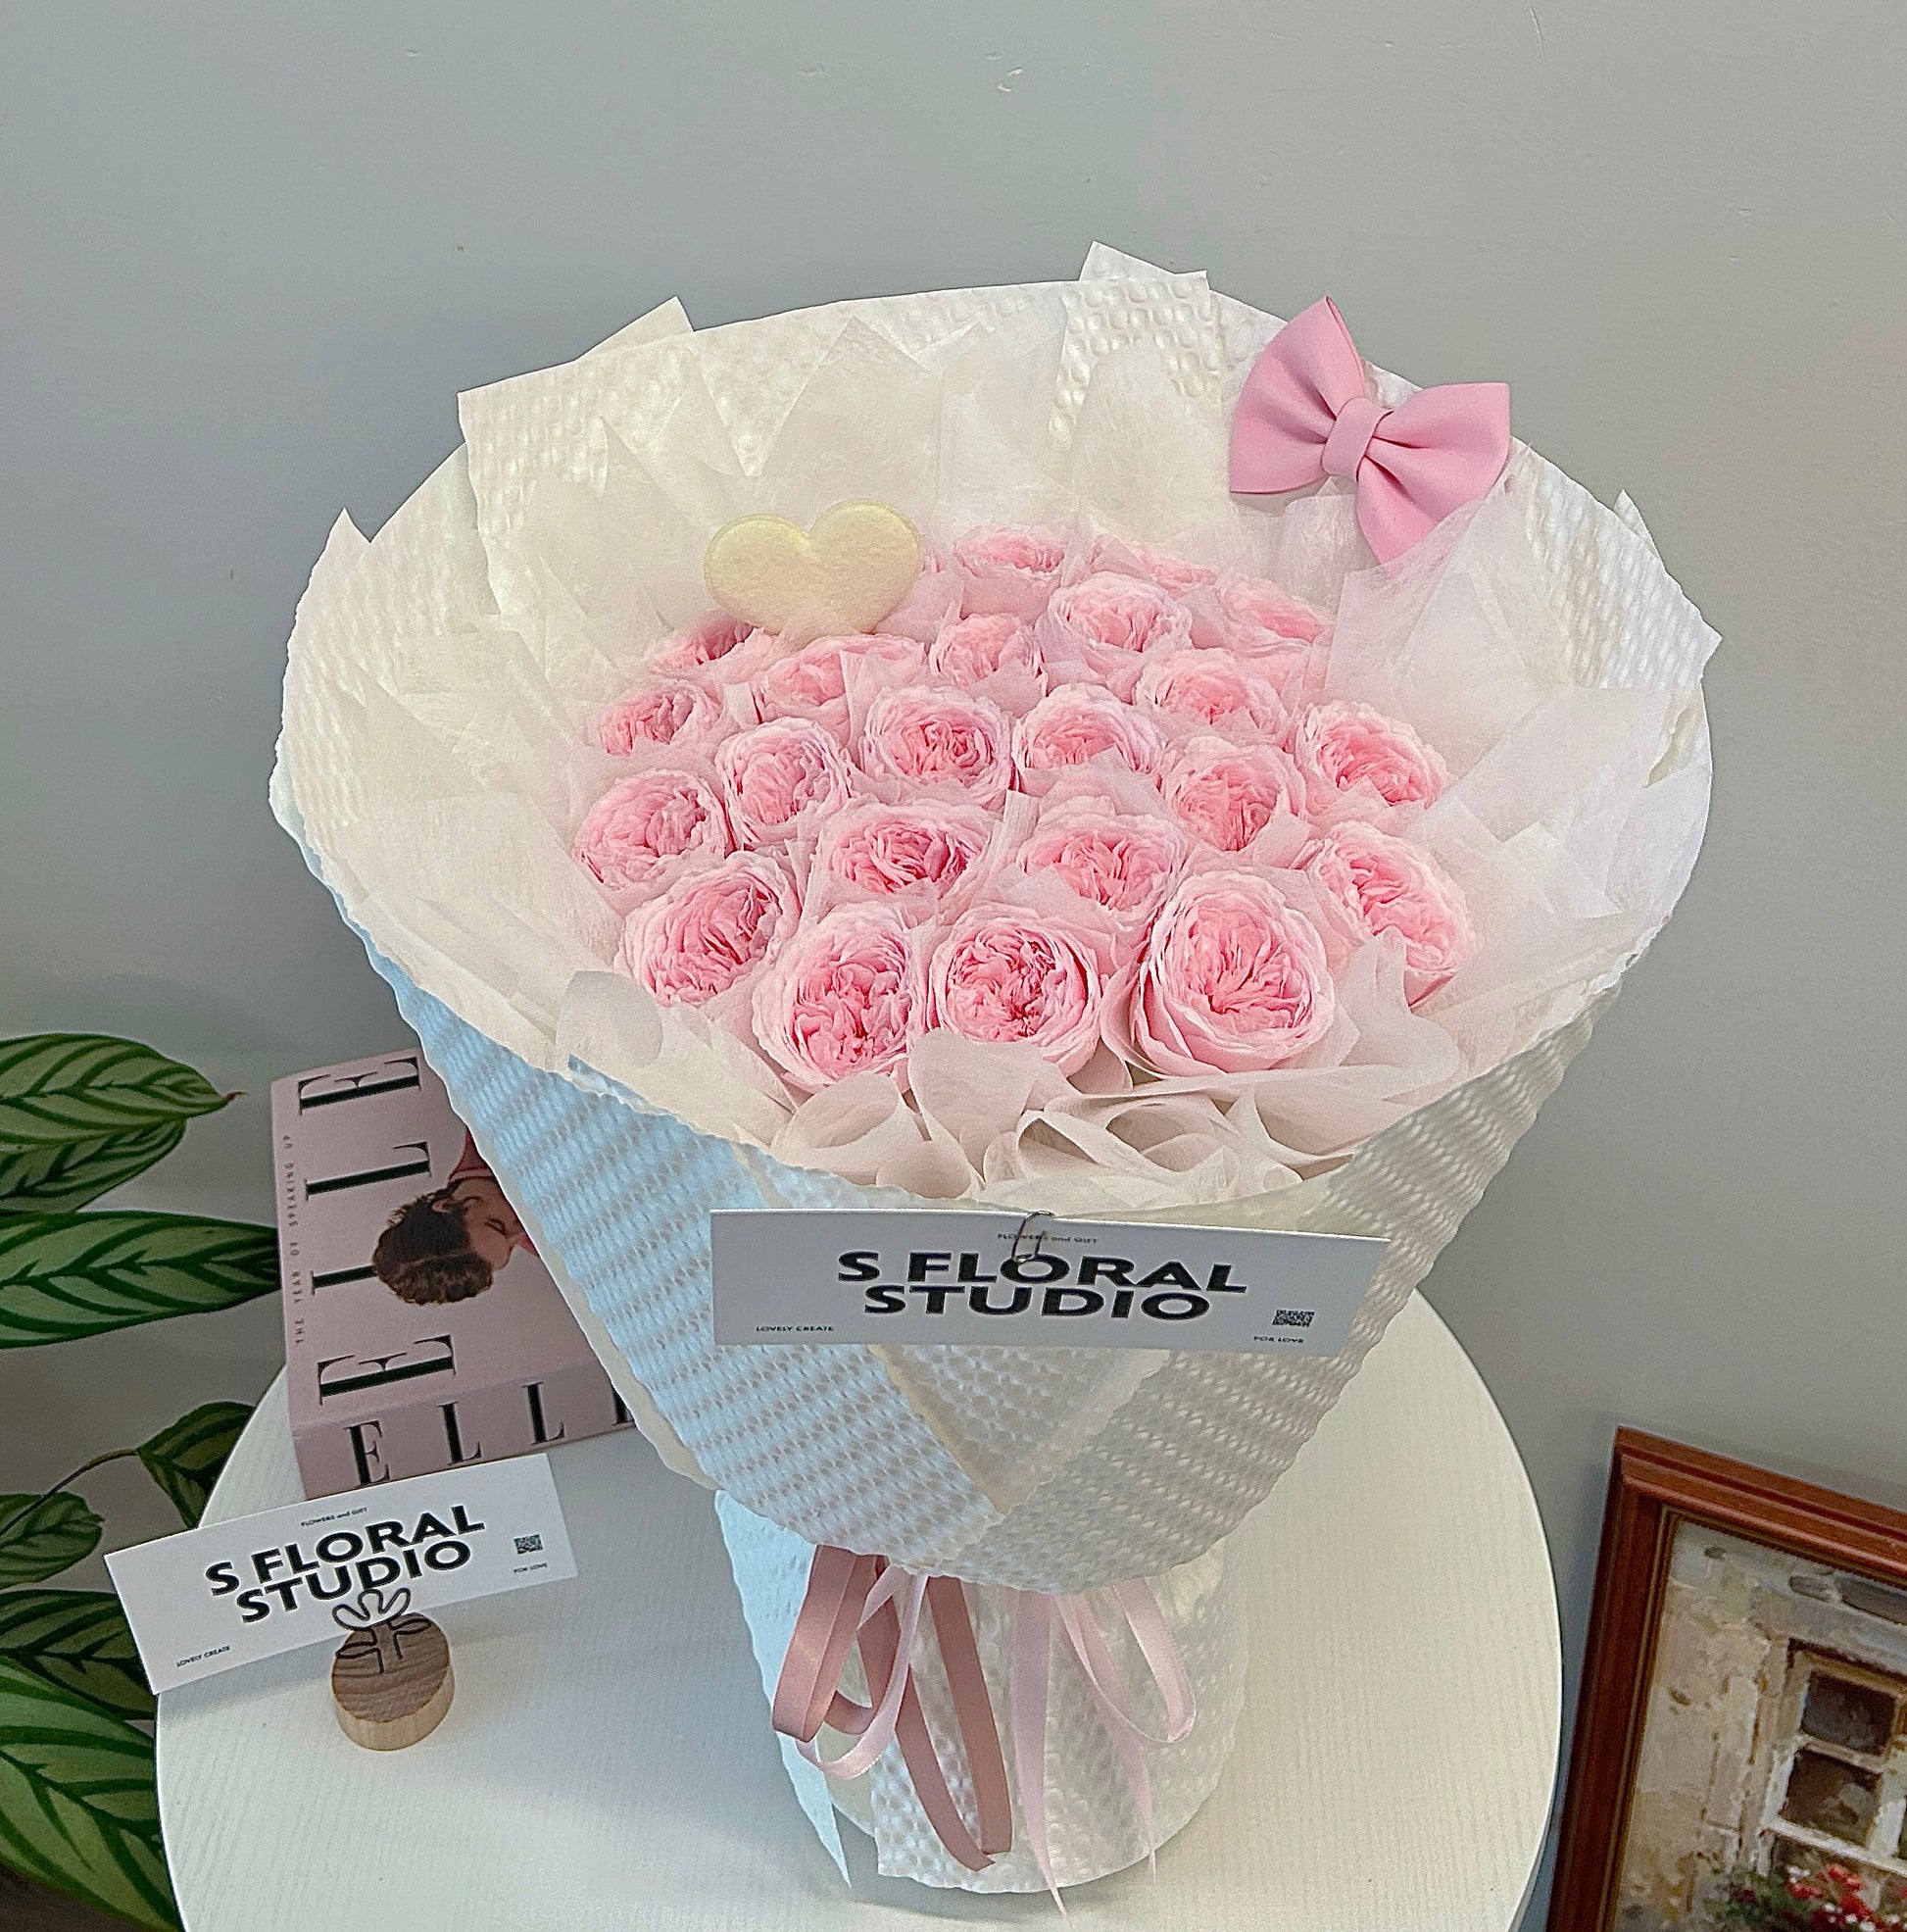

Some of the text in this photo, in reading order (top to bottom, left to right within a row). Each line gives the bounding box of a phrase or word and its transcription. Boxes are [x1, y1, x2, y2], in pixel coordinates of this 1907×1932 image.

[282, 1135, 306, 1345] THE YEAR OF SPEAKING UP
[837, 1251, 1247, 1294] S FLORAL
[864, 1284, 1210, 1320] STUDIO
[204, 1505, 486, 1596] S FLORAL
[529, 1561, 548, 1570] LOVE
[236, 1539, 471, 1623] STUDIO
[176, 1645, 231, 1667] LOVELY CREATE
